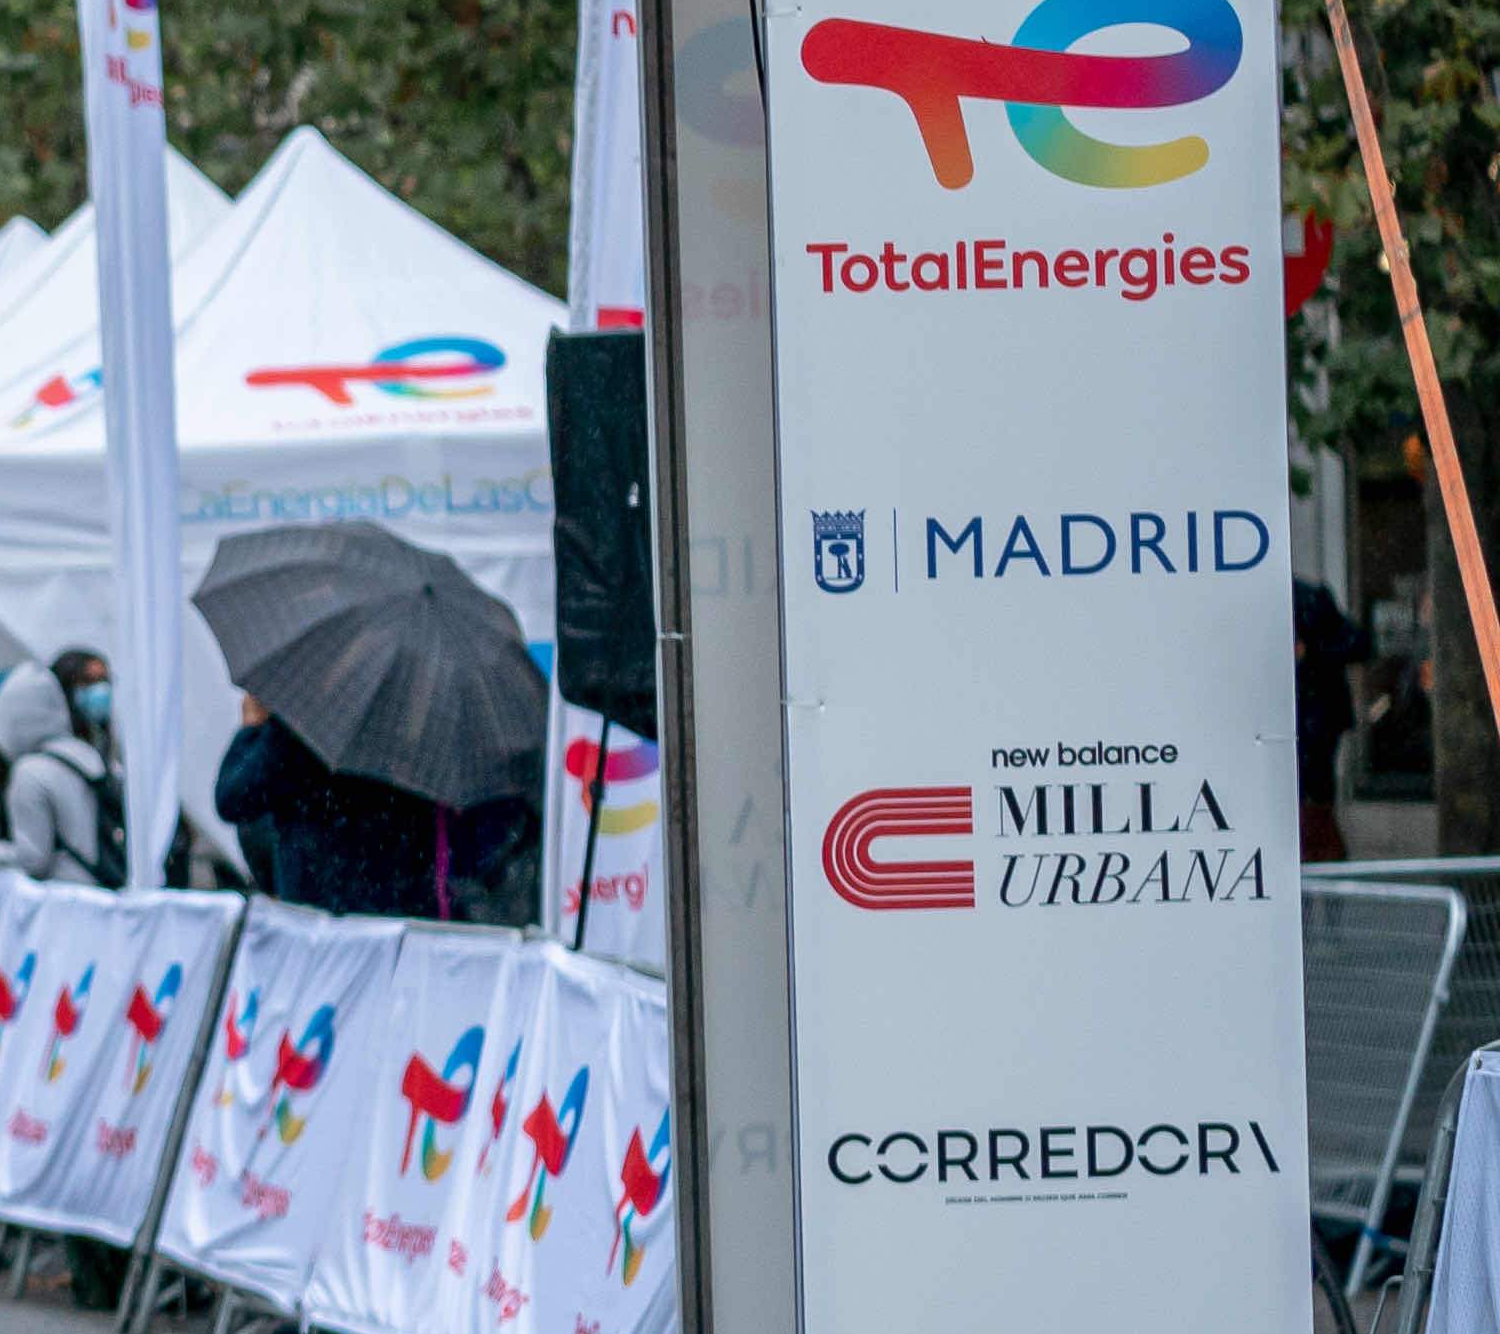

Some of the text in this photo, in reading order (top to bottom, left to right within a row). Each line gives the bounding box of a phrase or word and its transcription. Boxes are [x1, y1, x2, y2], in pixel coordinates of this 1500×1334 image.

[806, 233, 1250, 301] TotalEnergies
[927, 510, 1270, 579] MADRID
[991, 742, 1178, 768] new balance
[995, 779, 1234, 837] MILLA
[1000, 847, 1271, 907] URBANA
